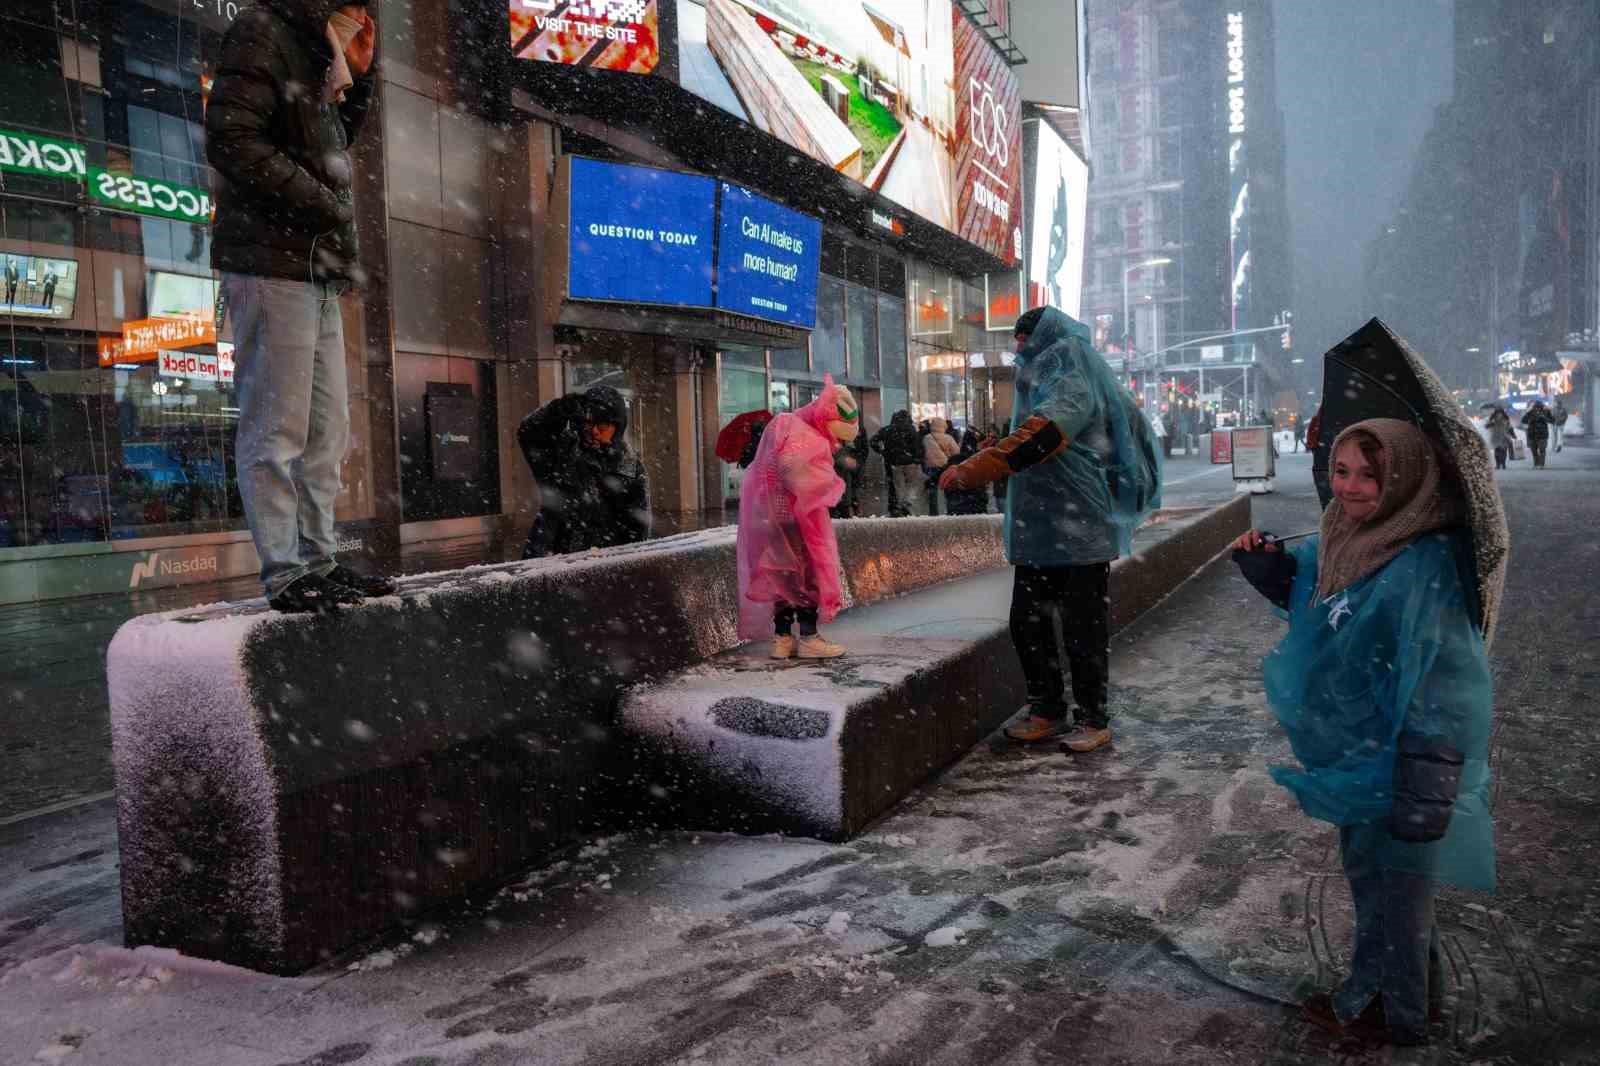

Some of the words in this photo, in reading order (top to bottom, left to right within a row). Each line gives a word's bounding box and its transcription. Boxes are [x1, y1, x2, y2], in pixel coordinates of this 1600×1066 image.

[534, 15, 571, 33] VISIT
[574, 21, 604, 38] THE
[606, 26, 638, 43] SITE
[590, 223, 654, 241] QUESTION
[659, 231, 698, 245] TODAY
[742, 216, 760, 240] Can
[761, 223, 770, 243] AI
[771, 231, 793, 251] make
[793, 239, 803, 255] us
[744, 252, 766, 273] more
[767, 256, 798, 282] human?
[161, 556, 217, 574] Nasdaq
